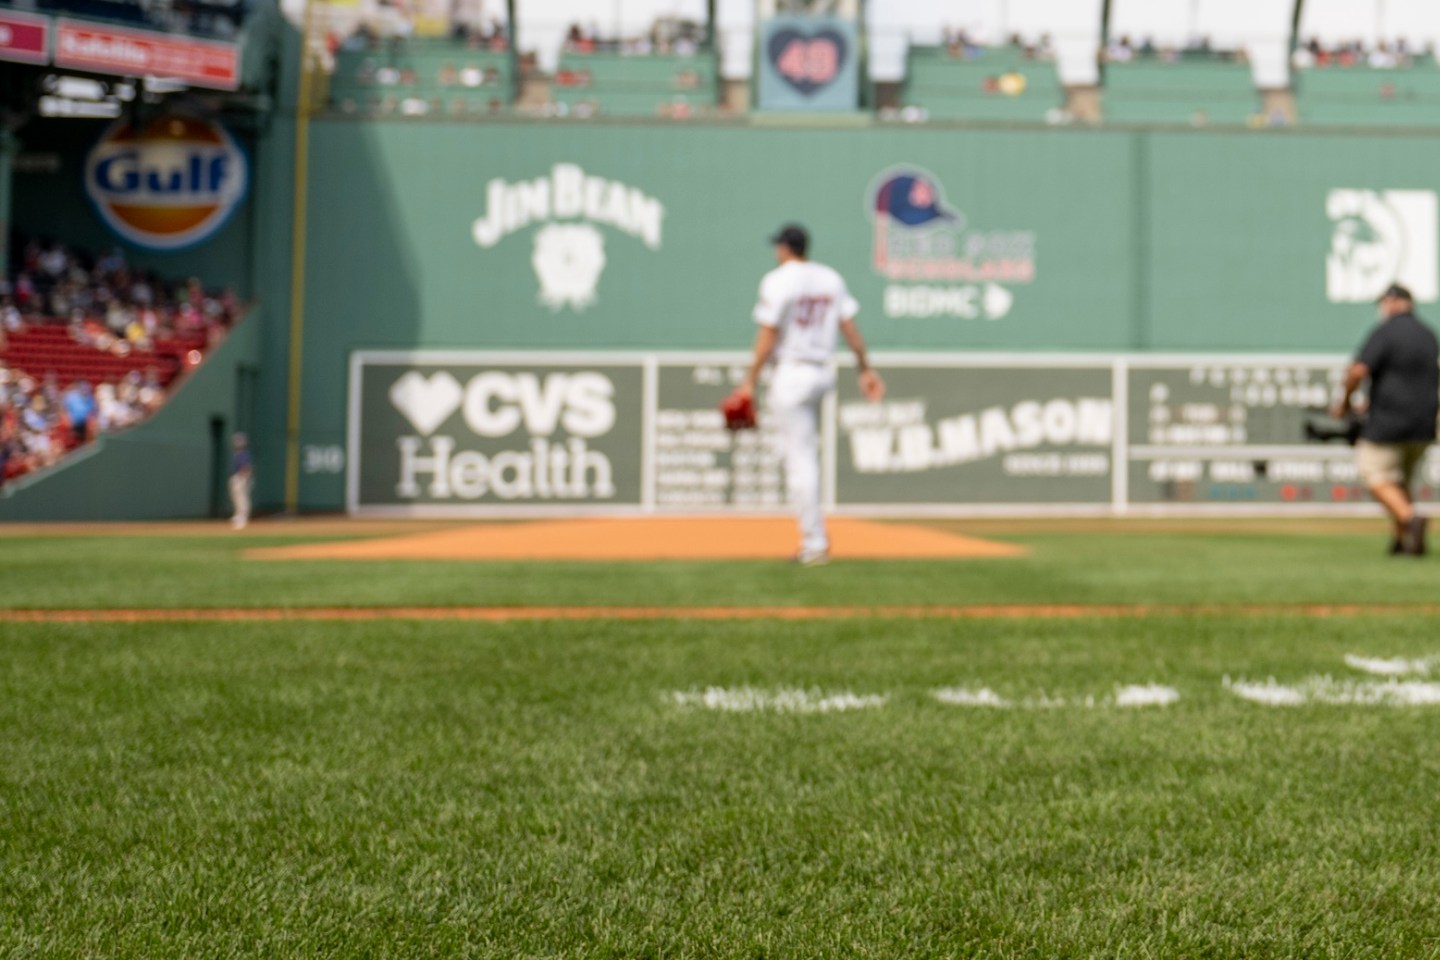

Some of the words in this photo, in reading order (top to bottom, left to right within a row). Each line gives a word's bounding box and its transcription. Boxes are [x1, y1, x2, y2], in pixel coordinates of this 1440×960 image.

[96, 152, 229, 192] Gulf
[472, 176, 551, 248] JIM
[552, 162, 665, 252] BEAM
[463, 371, 617, 437] CVS
[395, 436, 617, 499] Health
